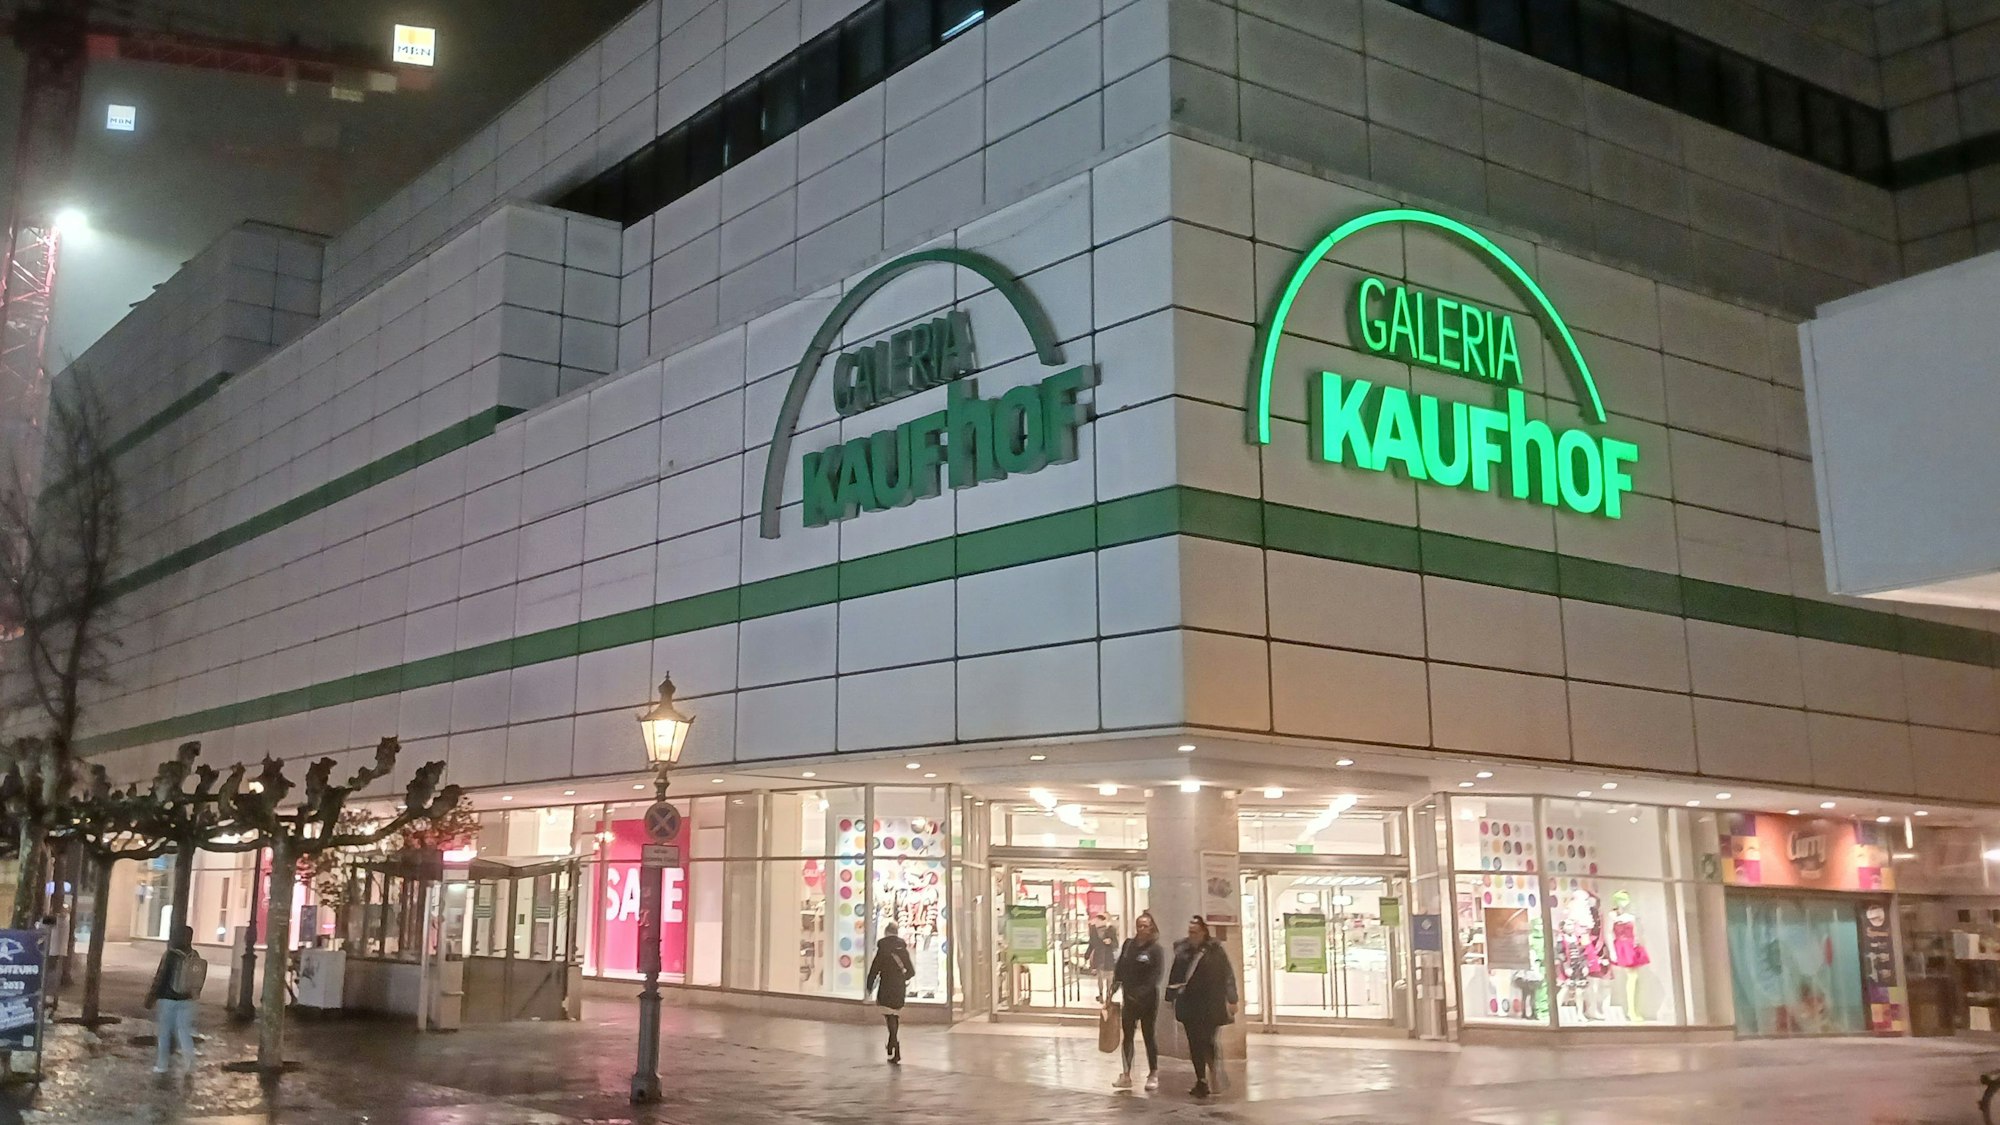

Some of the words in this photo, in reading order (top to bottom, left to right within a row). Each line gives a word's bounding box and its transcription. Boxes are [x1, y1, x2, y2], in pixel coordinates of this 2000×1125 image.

[833, 309, 977, 416] GALERIA
[1359, 277, 1523, 384] GALERIA
[606, 867, 684, 923] SAE
